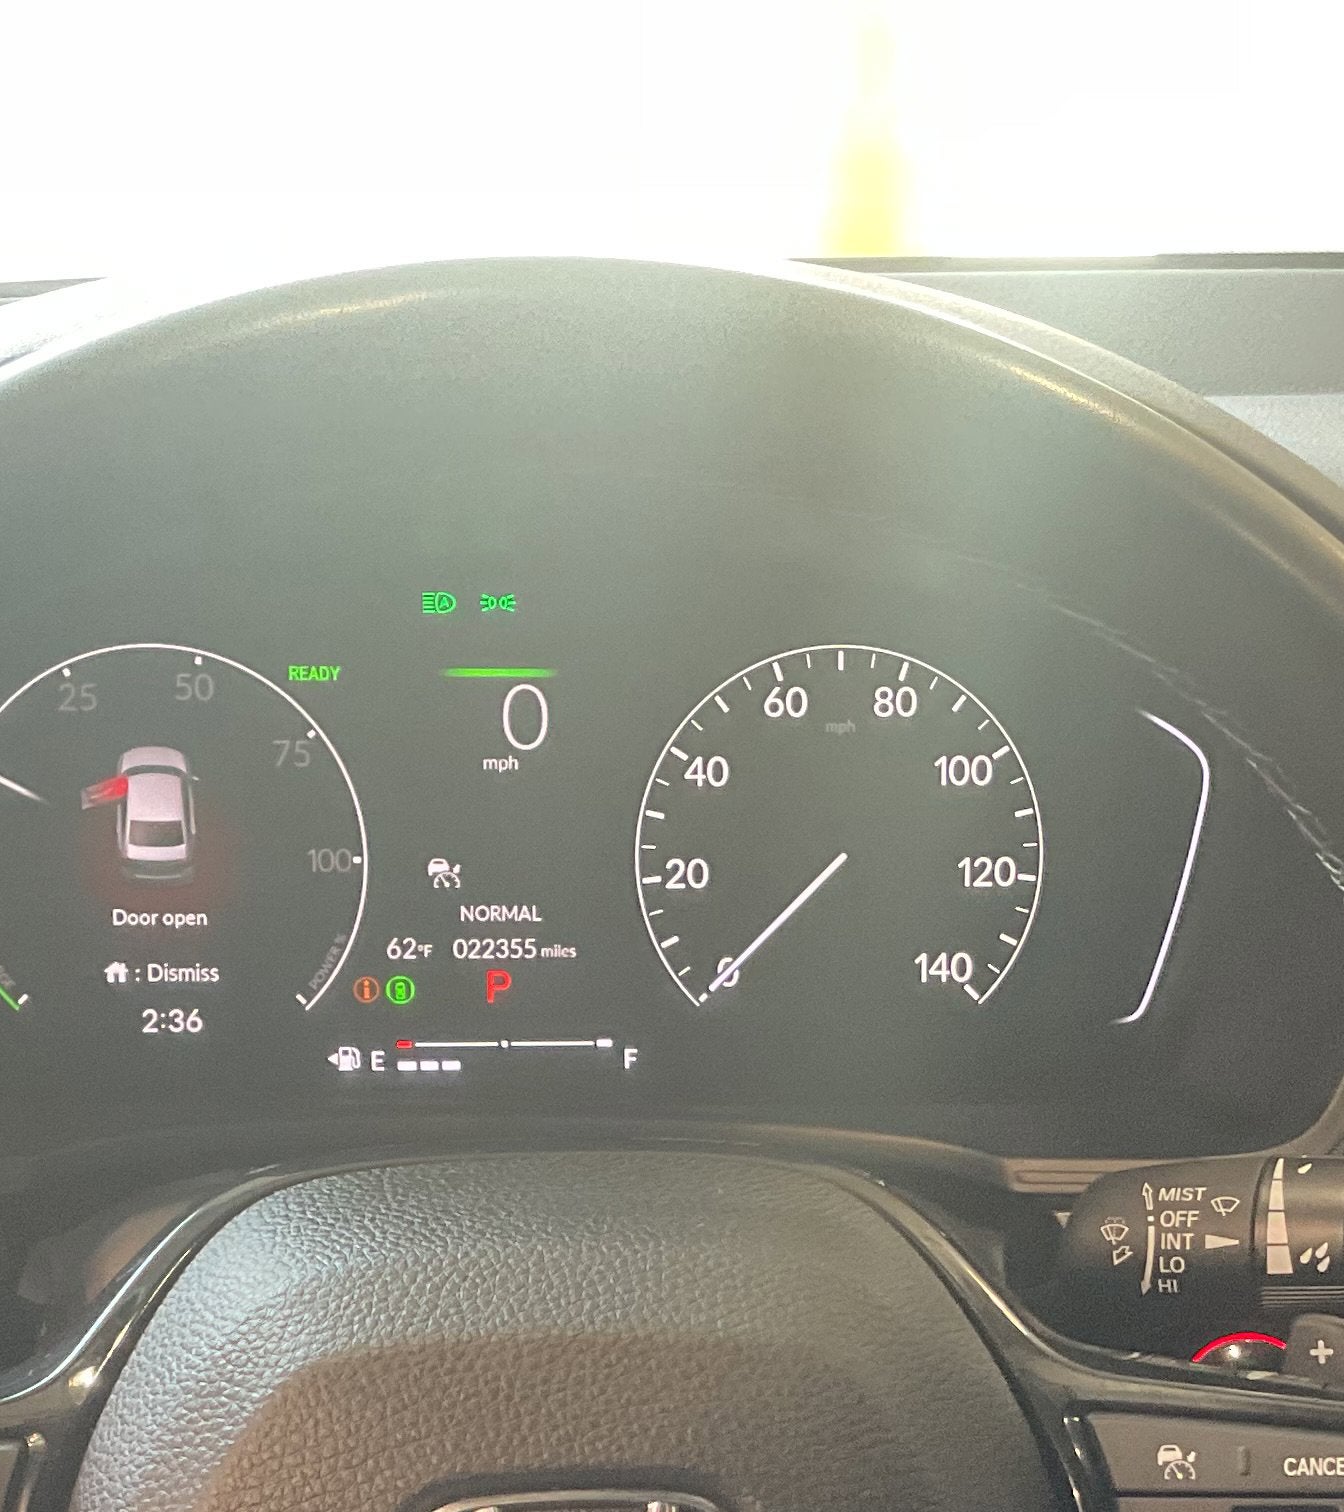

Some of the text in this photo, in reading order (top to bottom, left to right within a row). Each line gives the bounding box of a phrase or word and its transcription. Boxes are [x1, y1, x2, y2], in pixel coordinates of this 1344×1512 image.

[288, 665, 340, 681] READY
[57, 682, 98, 712] 25
[173, 673, 215, 702] 50
[763, 686, 808, 718] 60
[873, 686, 918, 718] 80
[501, 683, 549, 751] 0
[825, 720, 856, 735] mph
[273, 740, 312, 768] 75
[482, 755, 519, 774] mph
[683, 756, 729, 787] 40
[934, 755, 993, 786] 100
[307, 848, 352, 874] 100
[957, 856, 1016, 887] 120
[665, 858, 709, 889] 20
[112, 909, 208, 929] Door open
[460, 905, 542, 922] NORMAL
[453, 938, 576, 959] 022355 miles
[147, 963, 219, 982] Dismiss
[914, 953, 973, 983] 140
[486, 970, 512, 1003] P
[142, 1009, 203, 1033] 2:36
[370, 1050, 385, 1071] E
[624, 1048, 638, 1070] F
[1158, 1186, 1207, 1203] MIST
[1160, 1210, 1199, 1228] OFF
[1160, 1233, 1194, 1251] INT
[1159, 1256, 1185, 1274] LO
[1158, 1279, 1179, 1293] HI
